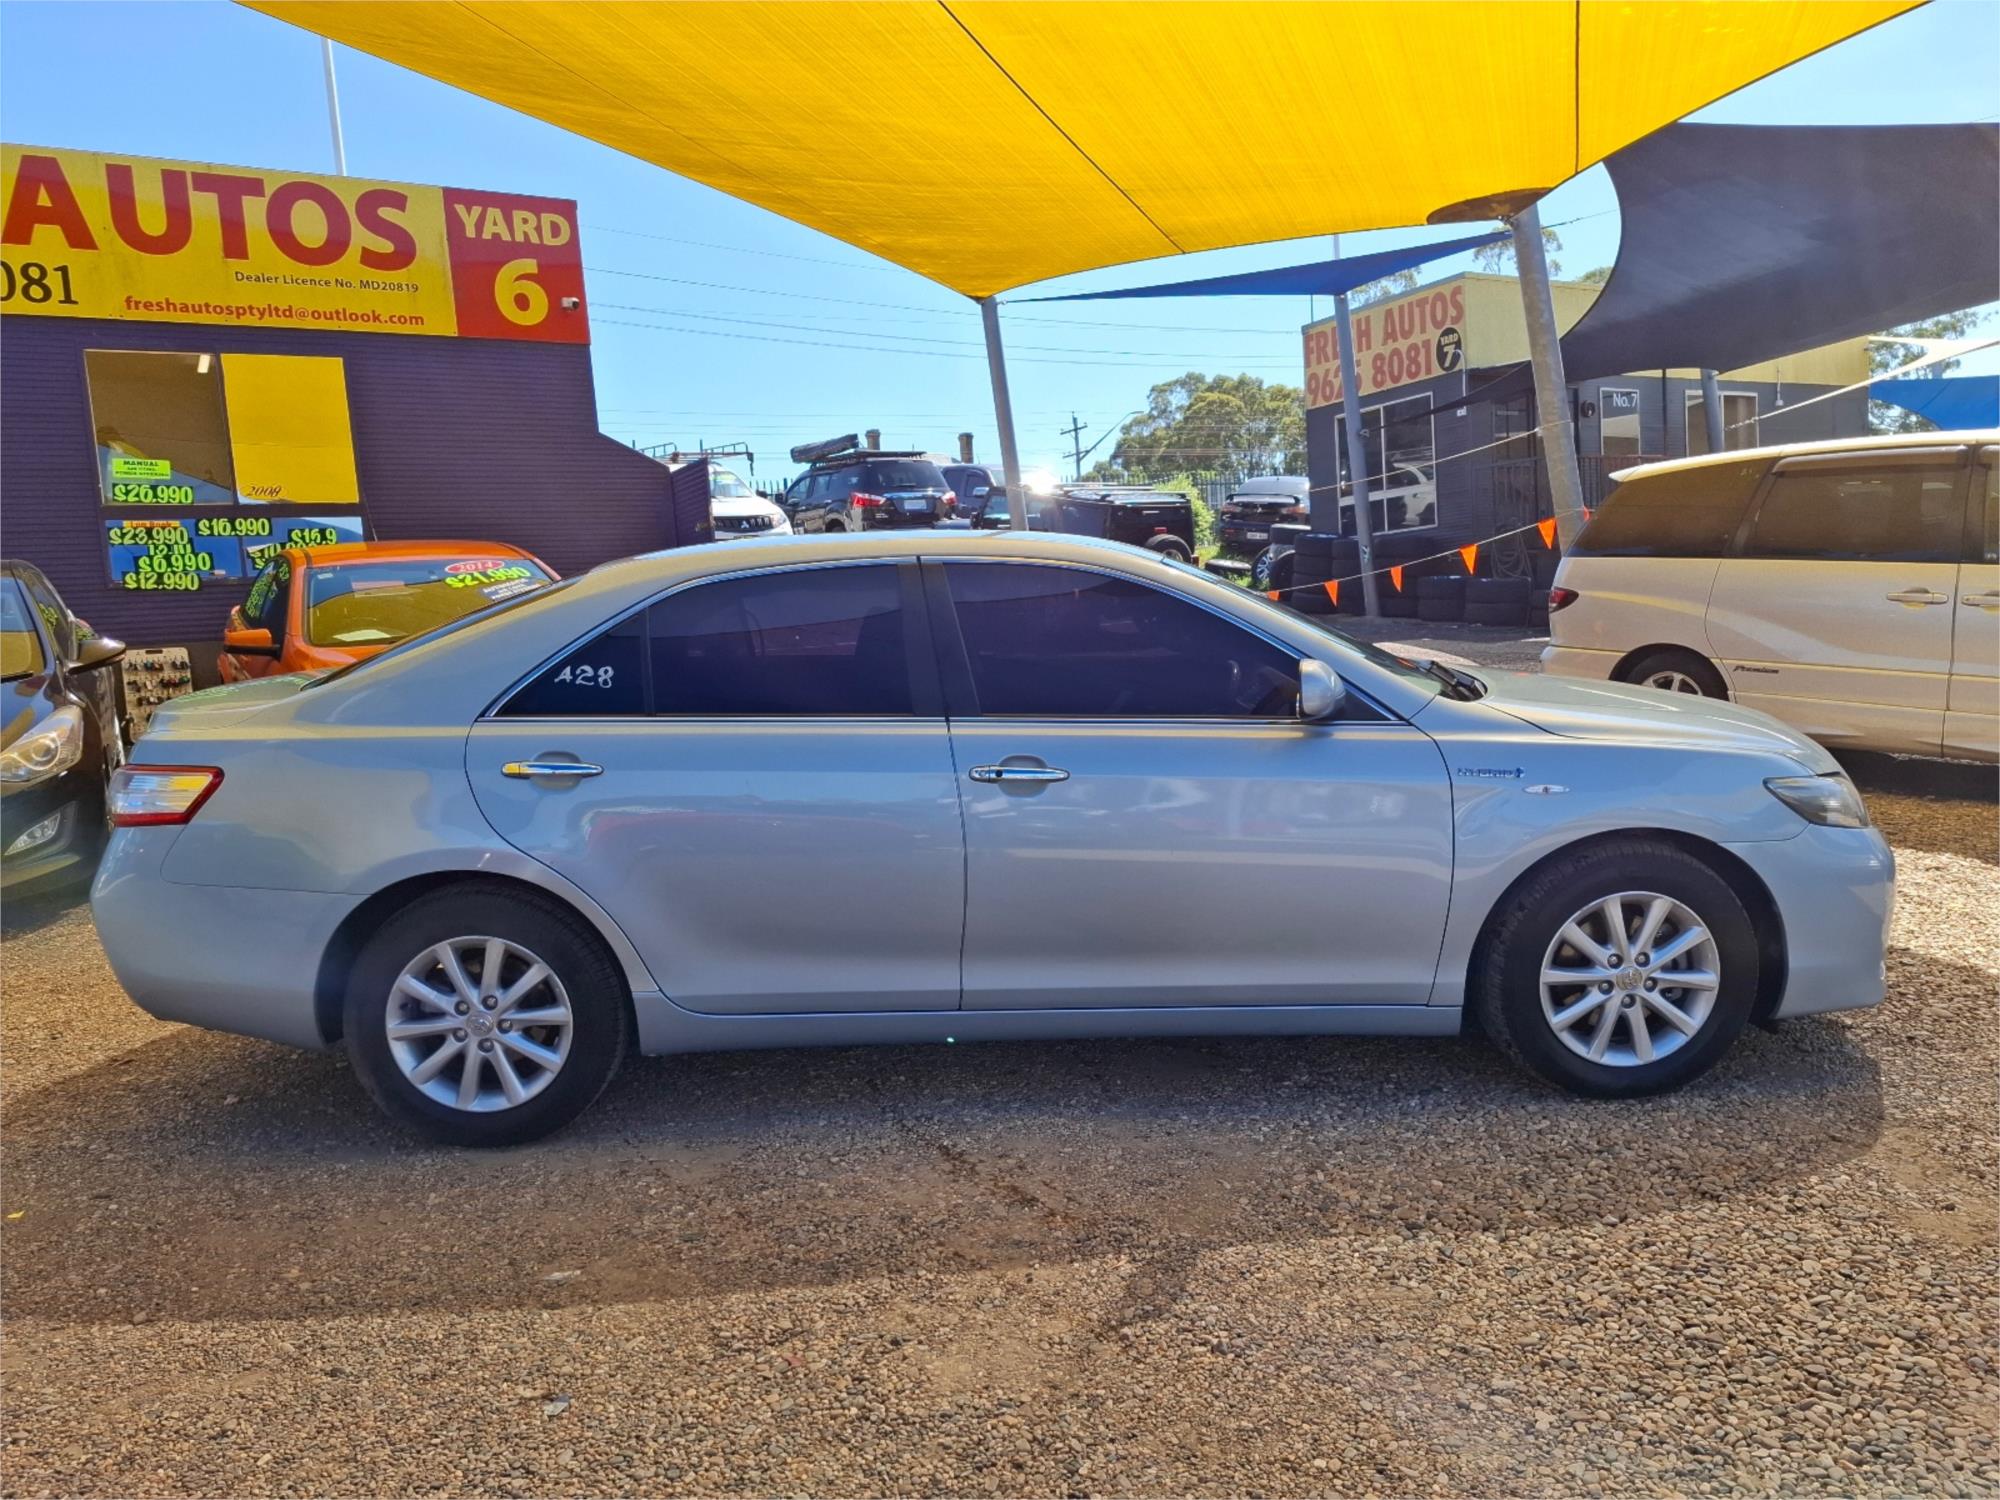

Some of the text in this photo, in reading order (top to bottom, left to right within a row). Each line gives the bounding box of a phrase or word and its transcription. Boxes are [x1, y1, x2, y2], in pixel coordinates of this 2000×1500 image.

[1, 154, 418, 272] AUTOS
[453, 203, 571, 246] YARD
[235, 271, 419, 293] Dealer Licence No. MD20819
[494, 258, 549, 326] 6
[124, 295, 425, 326] freshautosptyltd@outlook.com
[1382, 285, 1465, 346] AUTOS
[1440, 333, 1458, 346] YARD
[1371, 339, 1432, 389] 8081
[1443, 345, 1455, 368] 7
[1613, 392, 1637, 408] No. 7
[114, 484, 193, 503] $26.990
[109, 527, 188, 544] $23.990
[198, 518, 270, 536] $16.990
[138, 552, 211, 572] $6.990
[457, 561, 494, 571] 2014
[124, 572, 200, 590] $12.990
